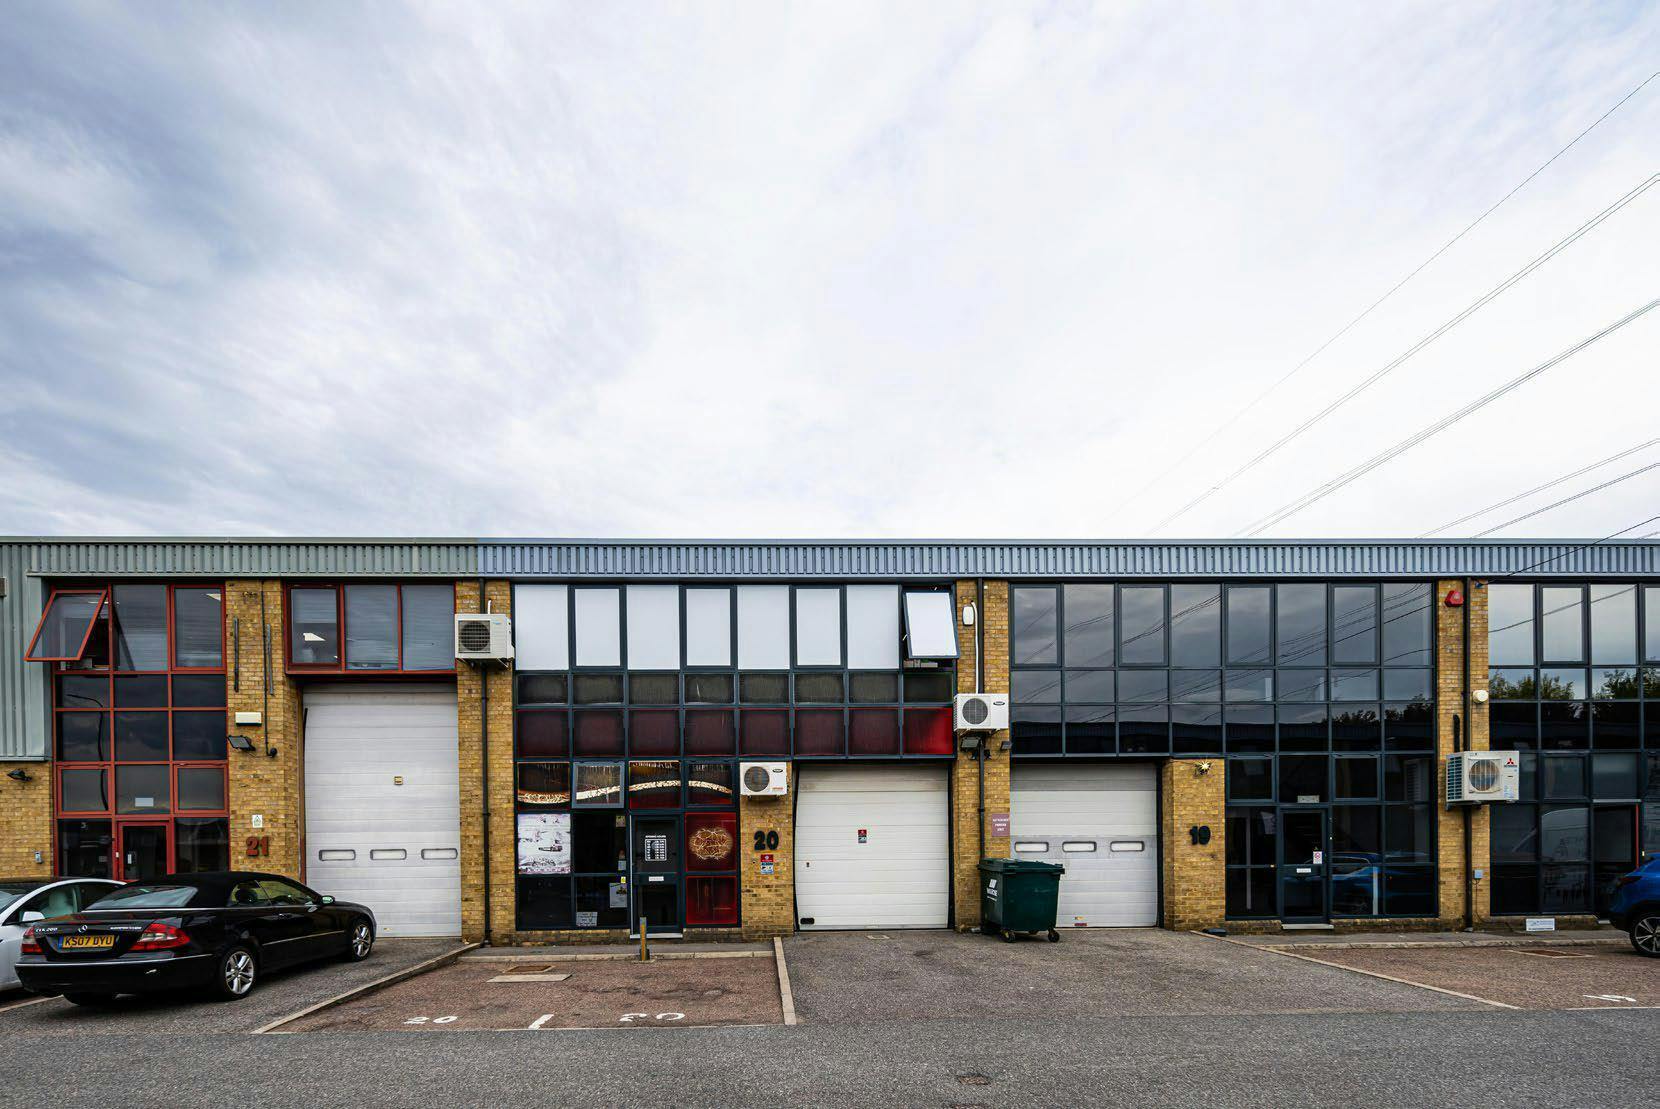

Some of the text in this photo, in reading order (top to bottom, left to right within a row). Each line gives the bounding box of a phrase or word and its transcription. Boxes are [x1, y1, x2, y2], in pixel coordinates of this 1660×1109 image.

[754, 830, 779, 850] 20
[1189, 825, 1211, 845] 19
[246, 836, 269, 856] 21
[65, 935, 113, 946] KS07 DYU
[403, 1015, 458, 1024] 20
